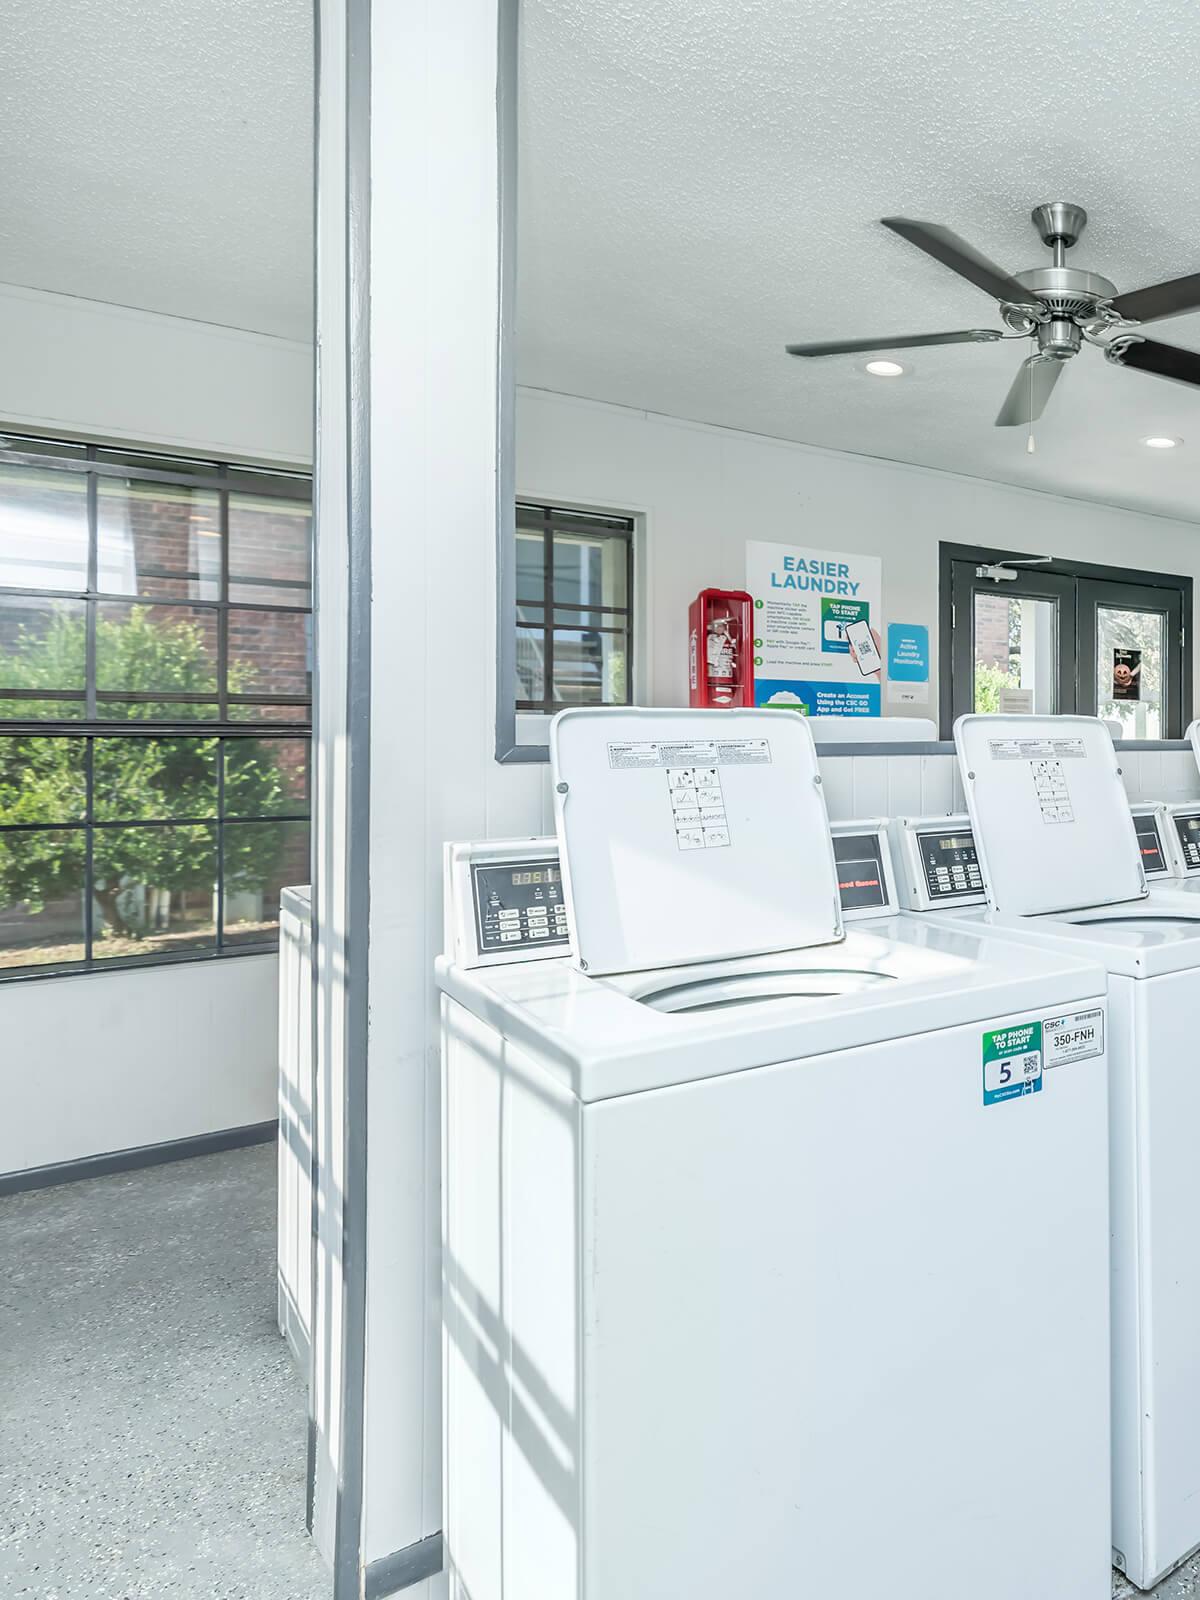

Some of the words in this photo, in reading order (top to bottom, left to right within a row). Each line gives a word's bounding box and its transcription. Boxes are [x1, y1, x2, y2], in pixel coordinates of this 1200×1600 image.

[783, 555, 849, 578] EASIER
[771, 572, 860, 596] LAUNDRY
[841, 604, 861, 612] PHONE
[893, 658, 924, 666] Monitoring
[897, 651, 920, 659] Laundry
[1044, 1020, 1060, 1029] CSC
[992, 1033, 1007, 1043] TAP
[1008, 1027, 1034, 1038] PHONE
[995, 1041, 1006, 1049] TO
[1007, 1035, 1031, 1047] START
[1054, 1028, 1094, 1047] 350-FNH
[1000, 1061, 1011, 1084] 5
